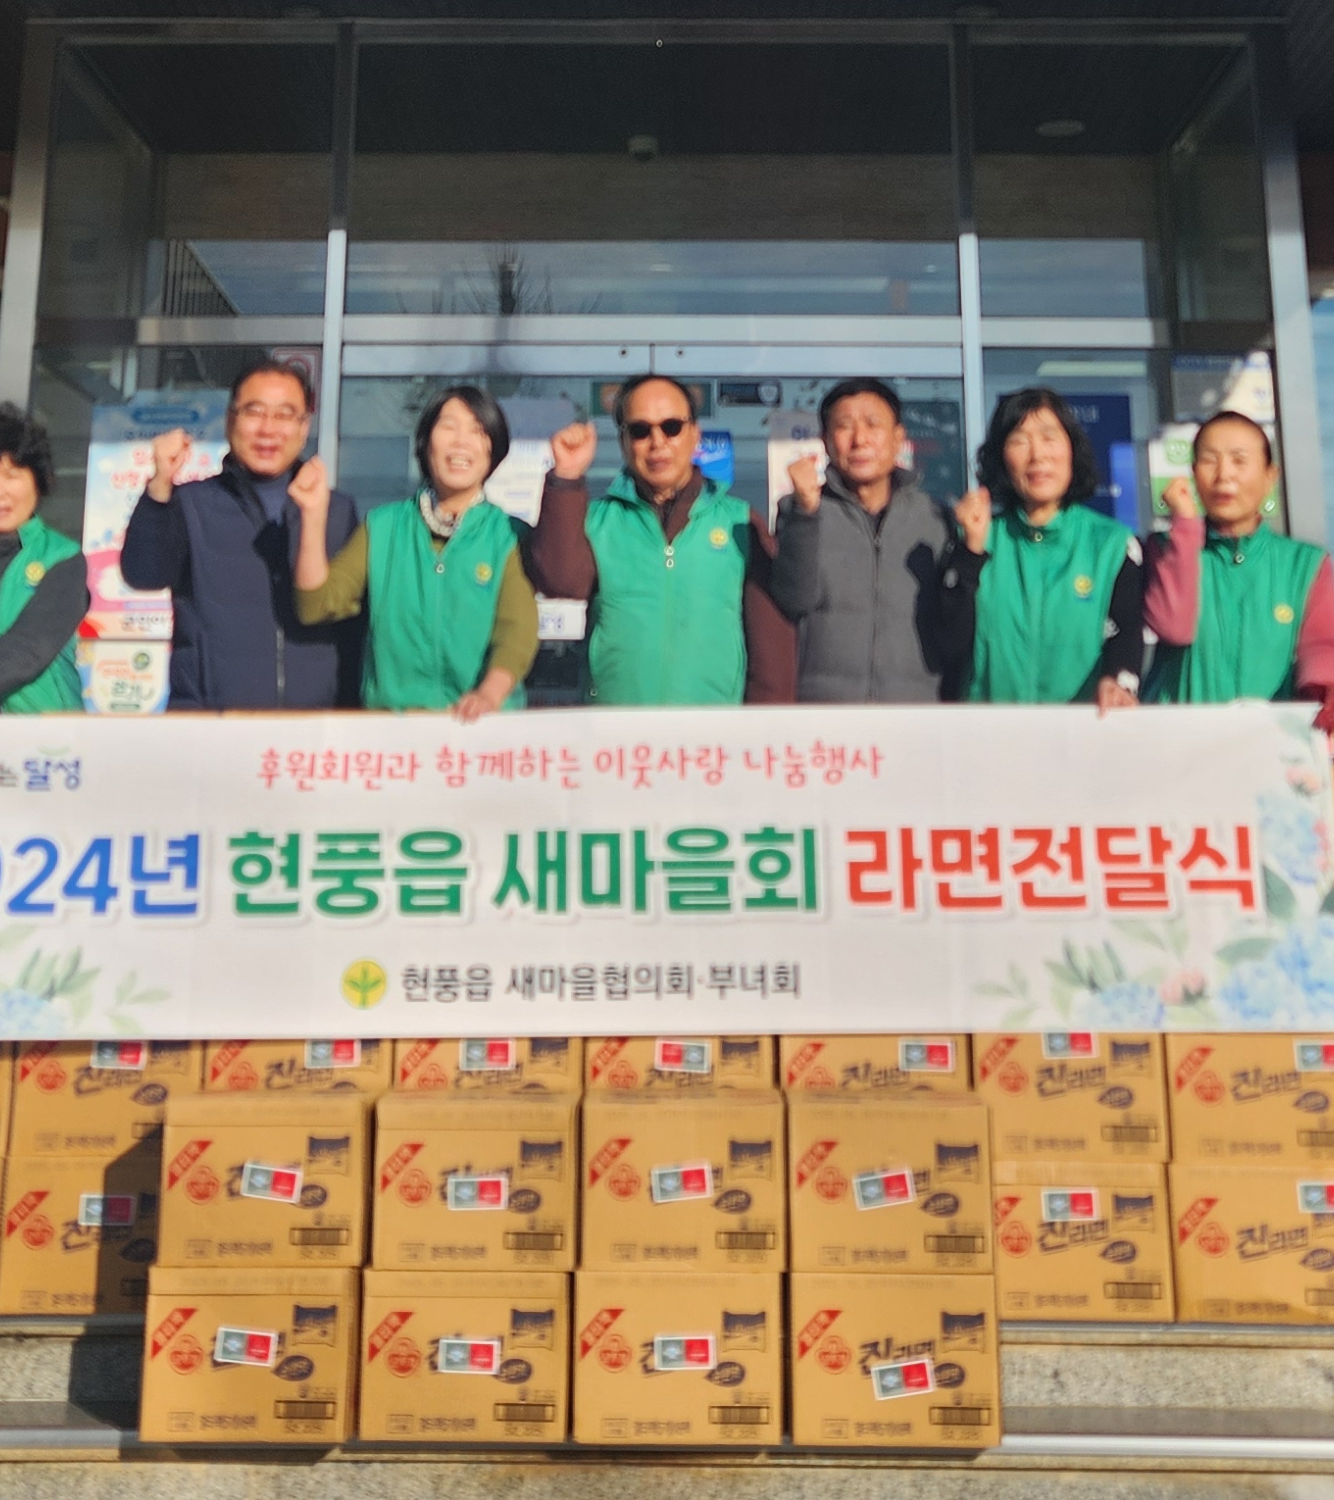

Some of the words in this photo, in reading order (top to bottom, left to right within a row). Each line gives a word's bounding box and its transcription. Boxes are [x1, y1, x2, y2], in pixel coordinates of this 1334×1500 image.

[23, 758, 82, 792] 달성
[256, 746, 423, 793] 후원회원과
[435, 744, 582, 791] 함께하는
[593, 743, 730, 790] 이웃사랑
[741, 740, 886, 791] 나눔행사
[228, 830, 470, 917] 현풍읍
[494, 826, 819, 913] 새마을회
[845, 824, 1258, 912] 라면전달식
[402, 965, 493, 1002] 현풍읍
